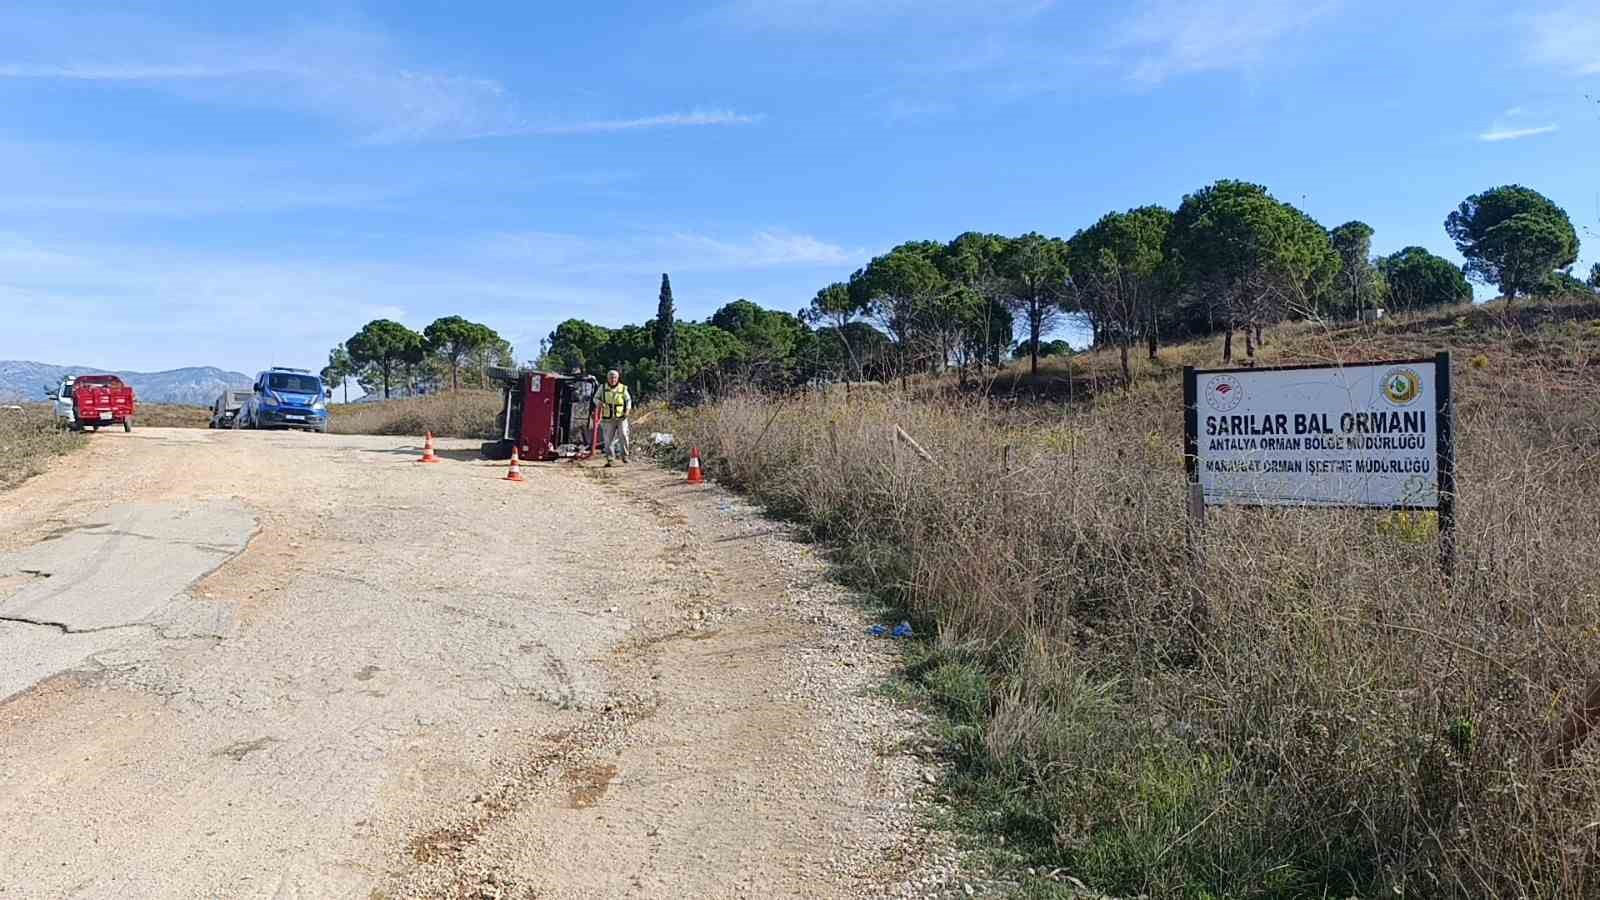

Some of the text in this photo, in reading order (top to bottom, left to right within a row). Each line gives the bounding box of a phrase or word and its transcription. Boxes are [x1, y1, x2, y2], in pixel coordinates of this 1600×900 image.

[1206, 411, 1426, 435] SARILAR BAL ORMANI
[1209, 438, 1257, 450] ANTALYA
[1260, 437, 1300, 450] ORMAN
[1263, 459, 1302, 473] ORMAN
[1355, 456, 1430, 473] MÜDÜRLÜĞÜ
